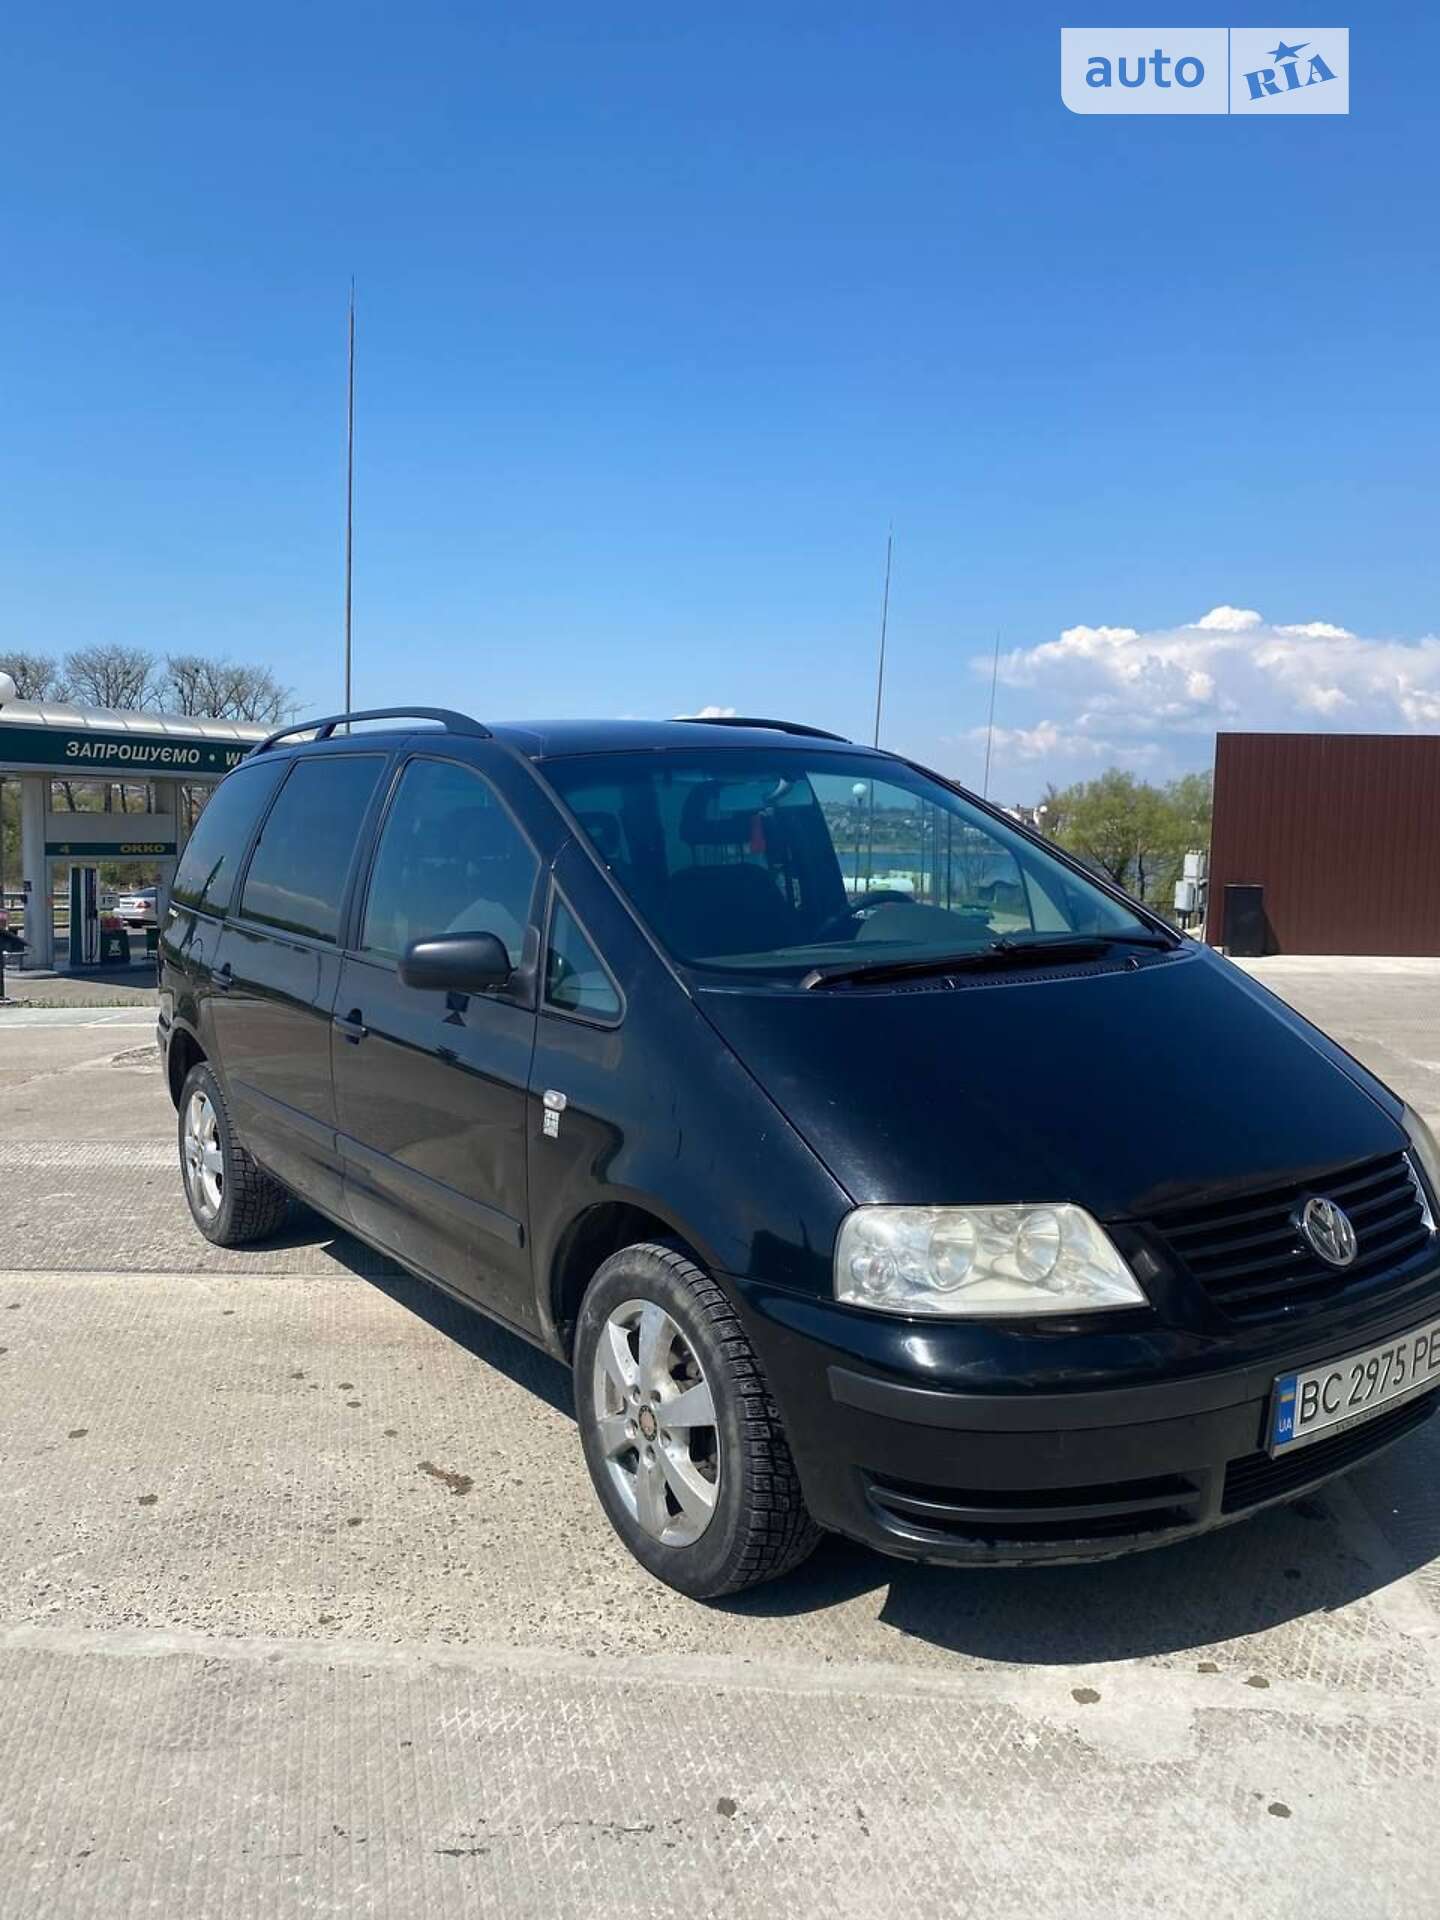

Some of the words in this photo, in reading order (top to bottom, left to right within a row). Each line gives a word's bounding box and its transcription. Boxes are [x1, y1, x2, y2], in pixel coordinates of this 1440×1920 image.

[66, 741, 200, 764] ЗАПРОШУЄМО
[120, 844, 166, 854] OKKO
[1300, 1372, 1342, 1425] BC
[1348, 1343, 1407, 1407] 2975
[1279, 1417, 1292, 1433] UA
